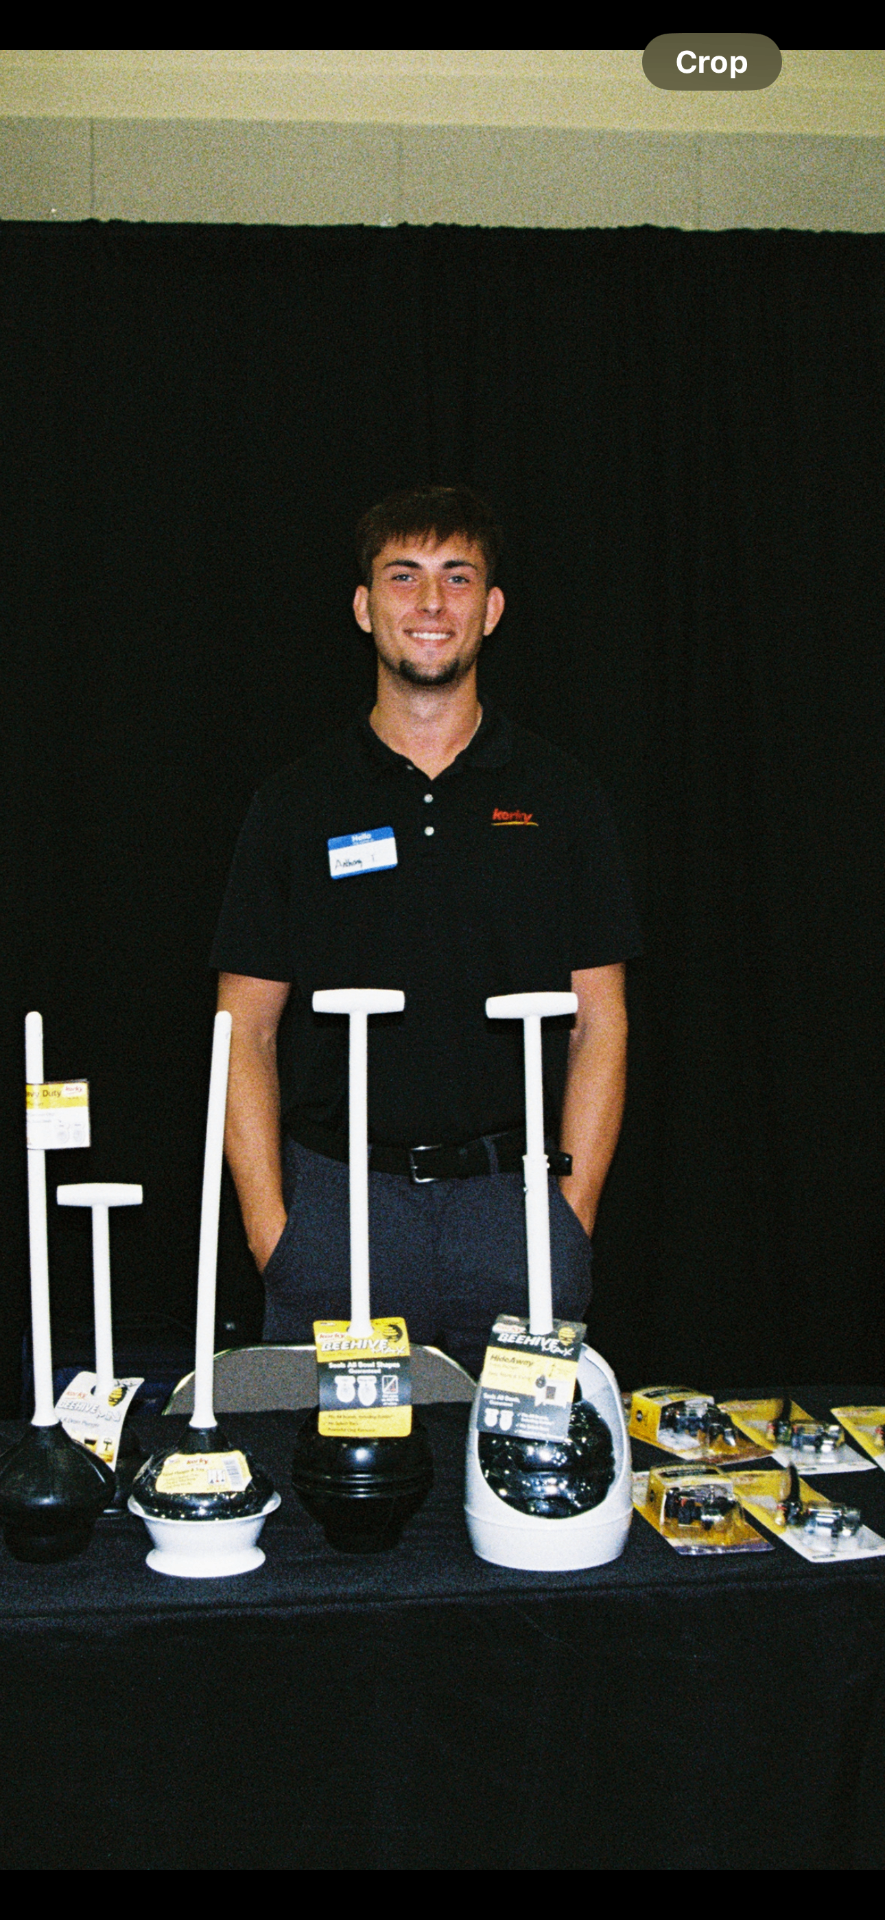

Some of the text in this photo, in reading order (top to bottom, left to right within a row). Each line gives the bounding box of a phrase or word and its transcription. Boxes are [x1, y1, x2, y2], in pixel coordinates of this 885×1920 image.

[351, 833, 372, 842] Hello
[42, 1089, 61, 1098] Duty
[321, 1339, 388, 1352] BEEHIVE
[497, 1333, 559, 1350] BEEHIVE
[490, 1353, 534, 1367] HideAway
[57, 1401, 99, 1414] BEEHIVE
